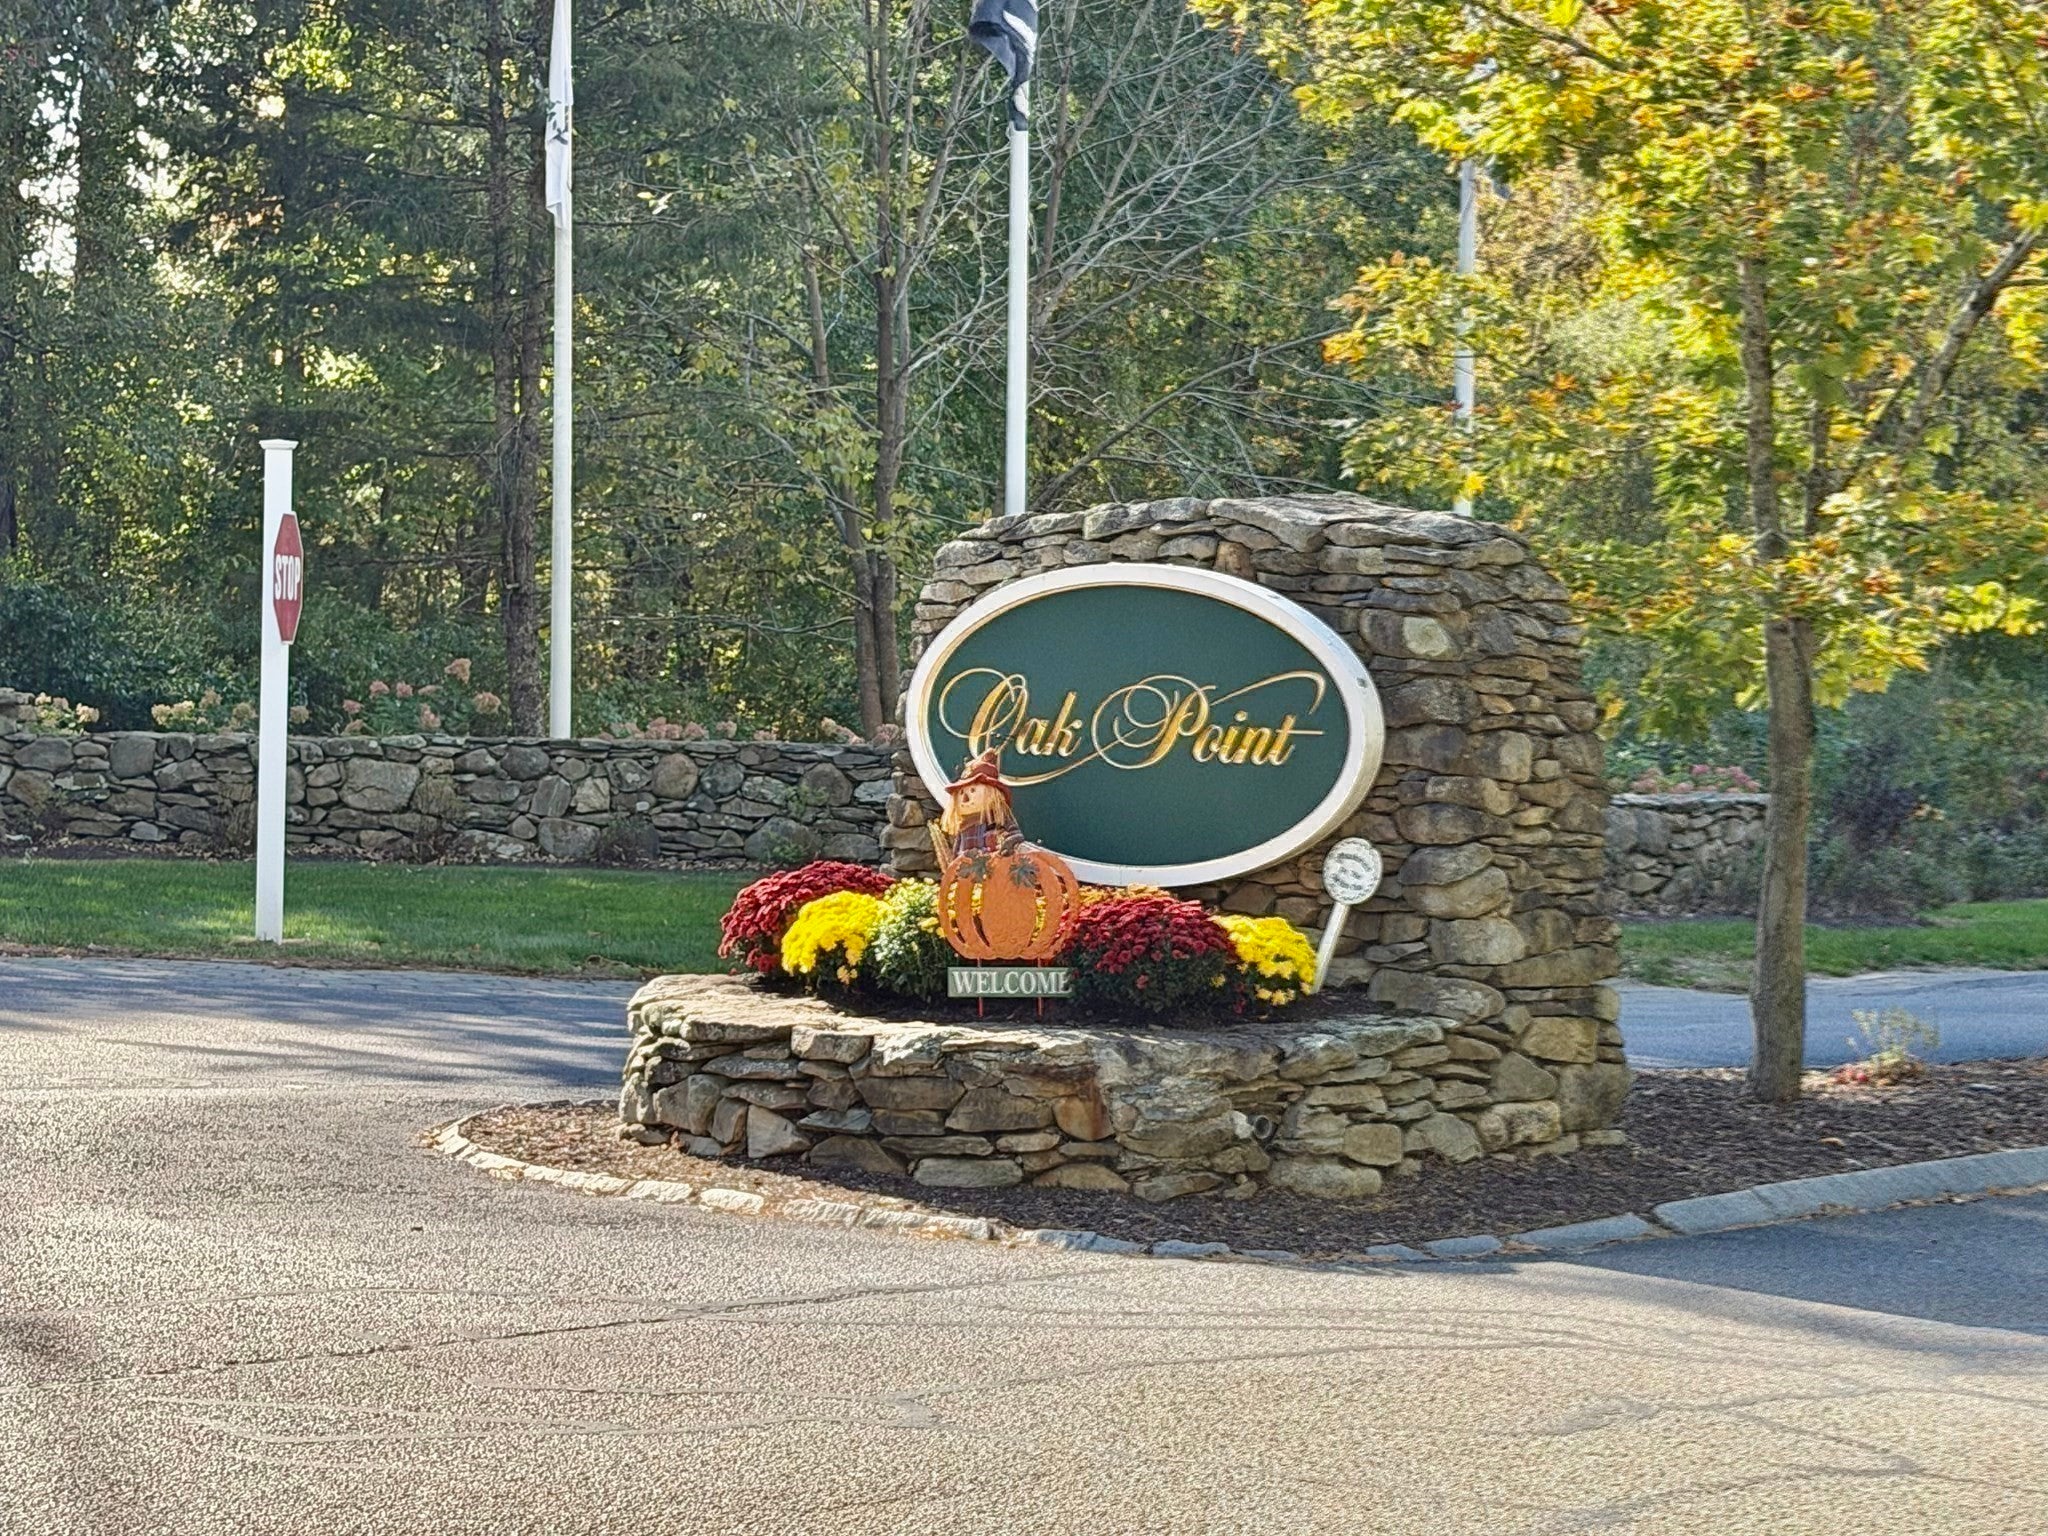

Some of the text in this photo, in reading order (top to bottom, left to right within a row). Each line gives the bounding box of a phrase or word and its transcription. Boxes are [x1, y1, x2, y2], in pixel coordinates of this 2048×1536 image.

[275, 554, 301, 601] STOP
[940, 668, 1324, 769] Oak Point
[952, 971, 1073, 995] WELCOME
